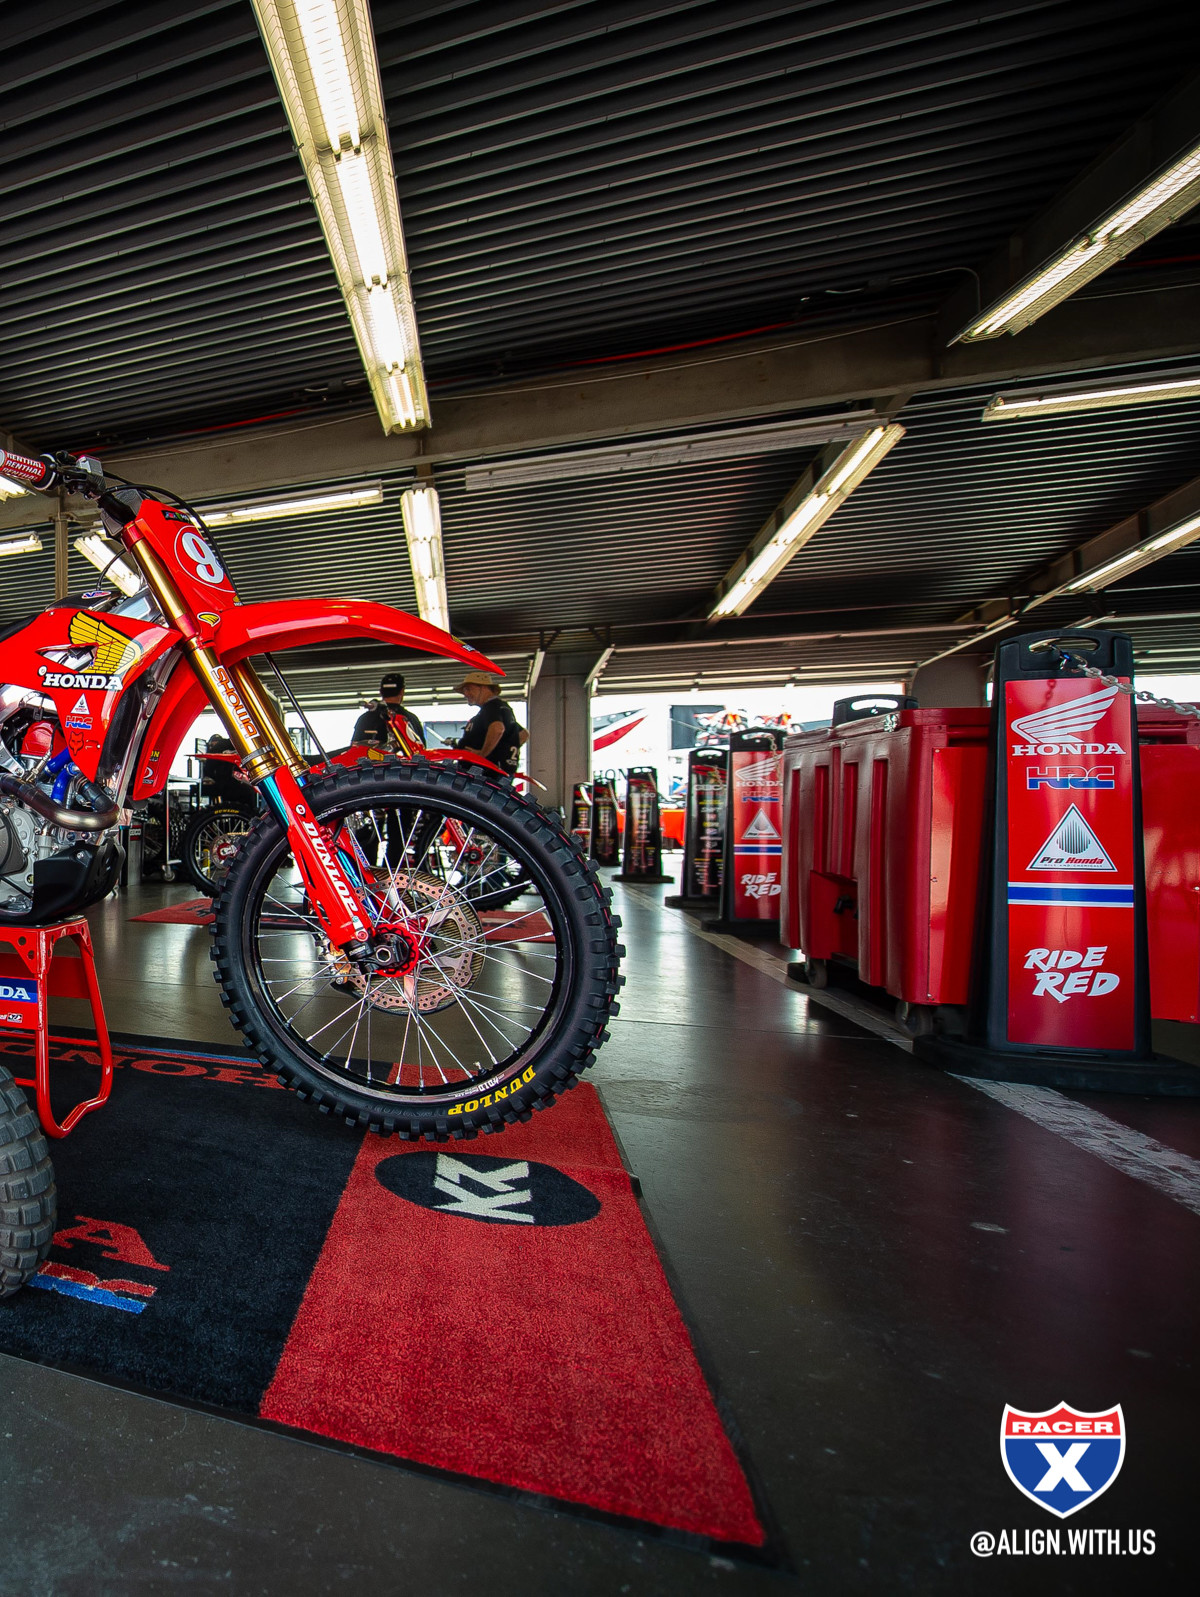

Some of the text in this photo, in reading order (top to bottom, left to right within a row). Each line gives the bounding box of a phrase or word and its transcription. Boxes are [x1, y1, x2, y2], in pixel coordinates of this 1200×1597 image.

[5, 459, 42, 477] RENTHAL
[42, 673, 124, 691] HONDA
[213, 668, 258, 738] SHOWA
[65, 715, 93, 730] HRC
[1011, 743, 1127, 756] HONDA
[1026, 765, 1115, 790] HRC
[302, 821, 358, 913] DUNLOP
[1039, 856, 1064, 864] Pro
[741, 872, 777, 885] RIDE
[744, 884, 782, 899] RED
[1023, 946, 1108, 972] RIDE
[1032, 970, 1120, 1003] RED
[447, 1065, 536, 1116] DUNLOP
